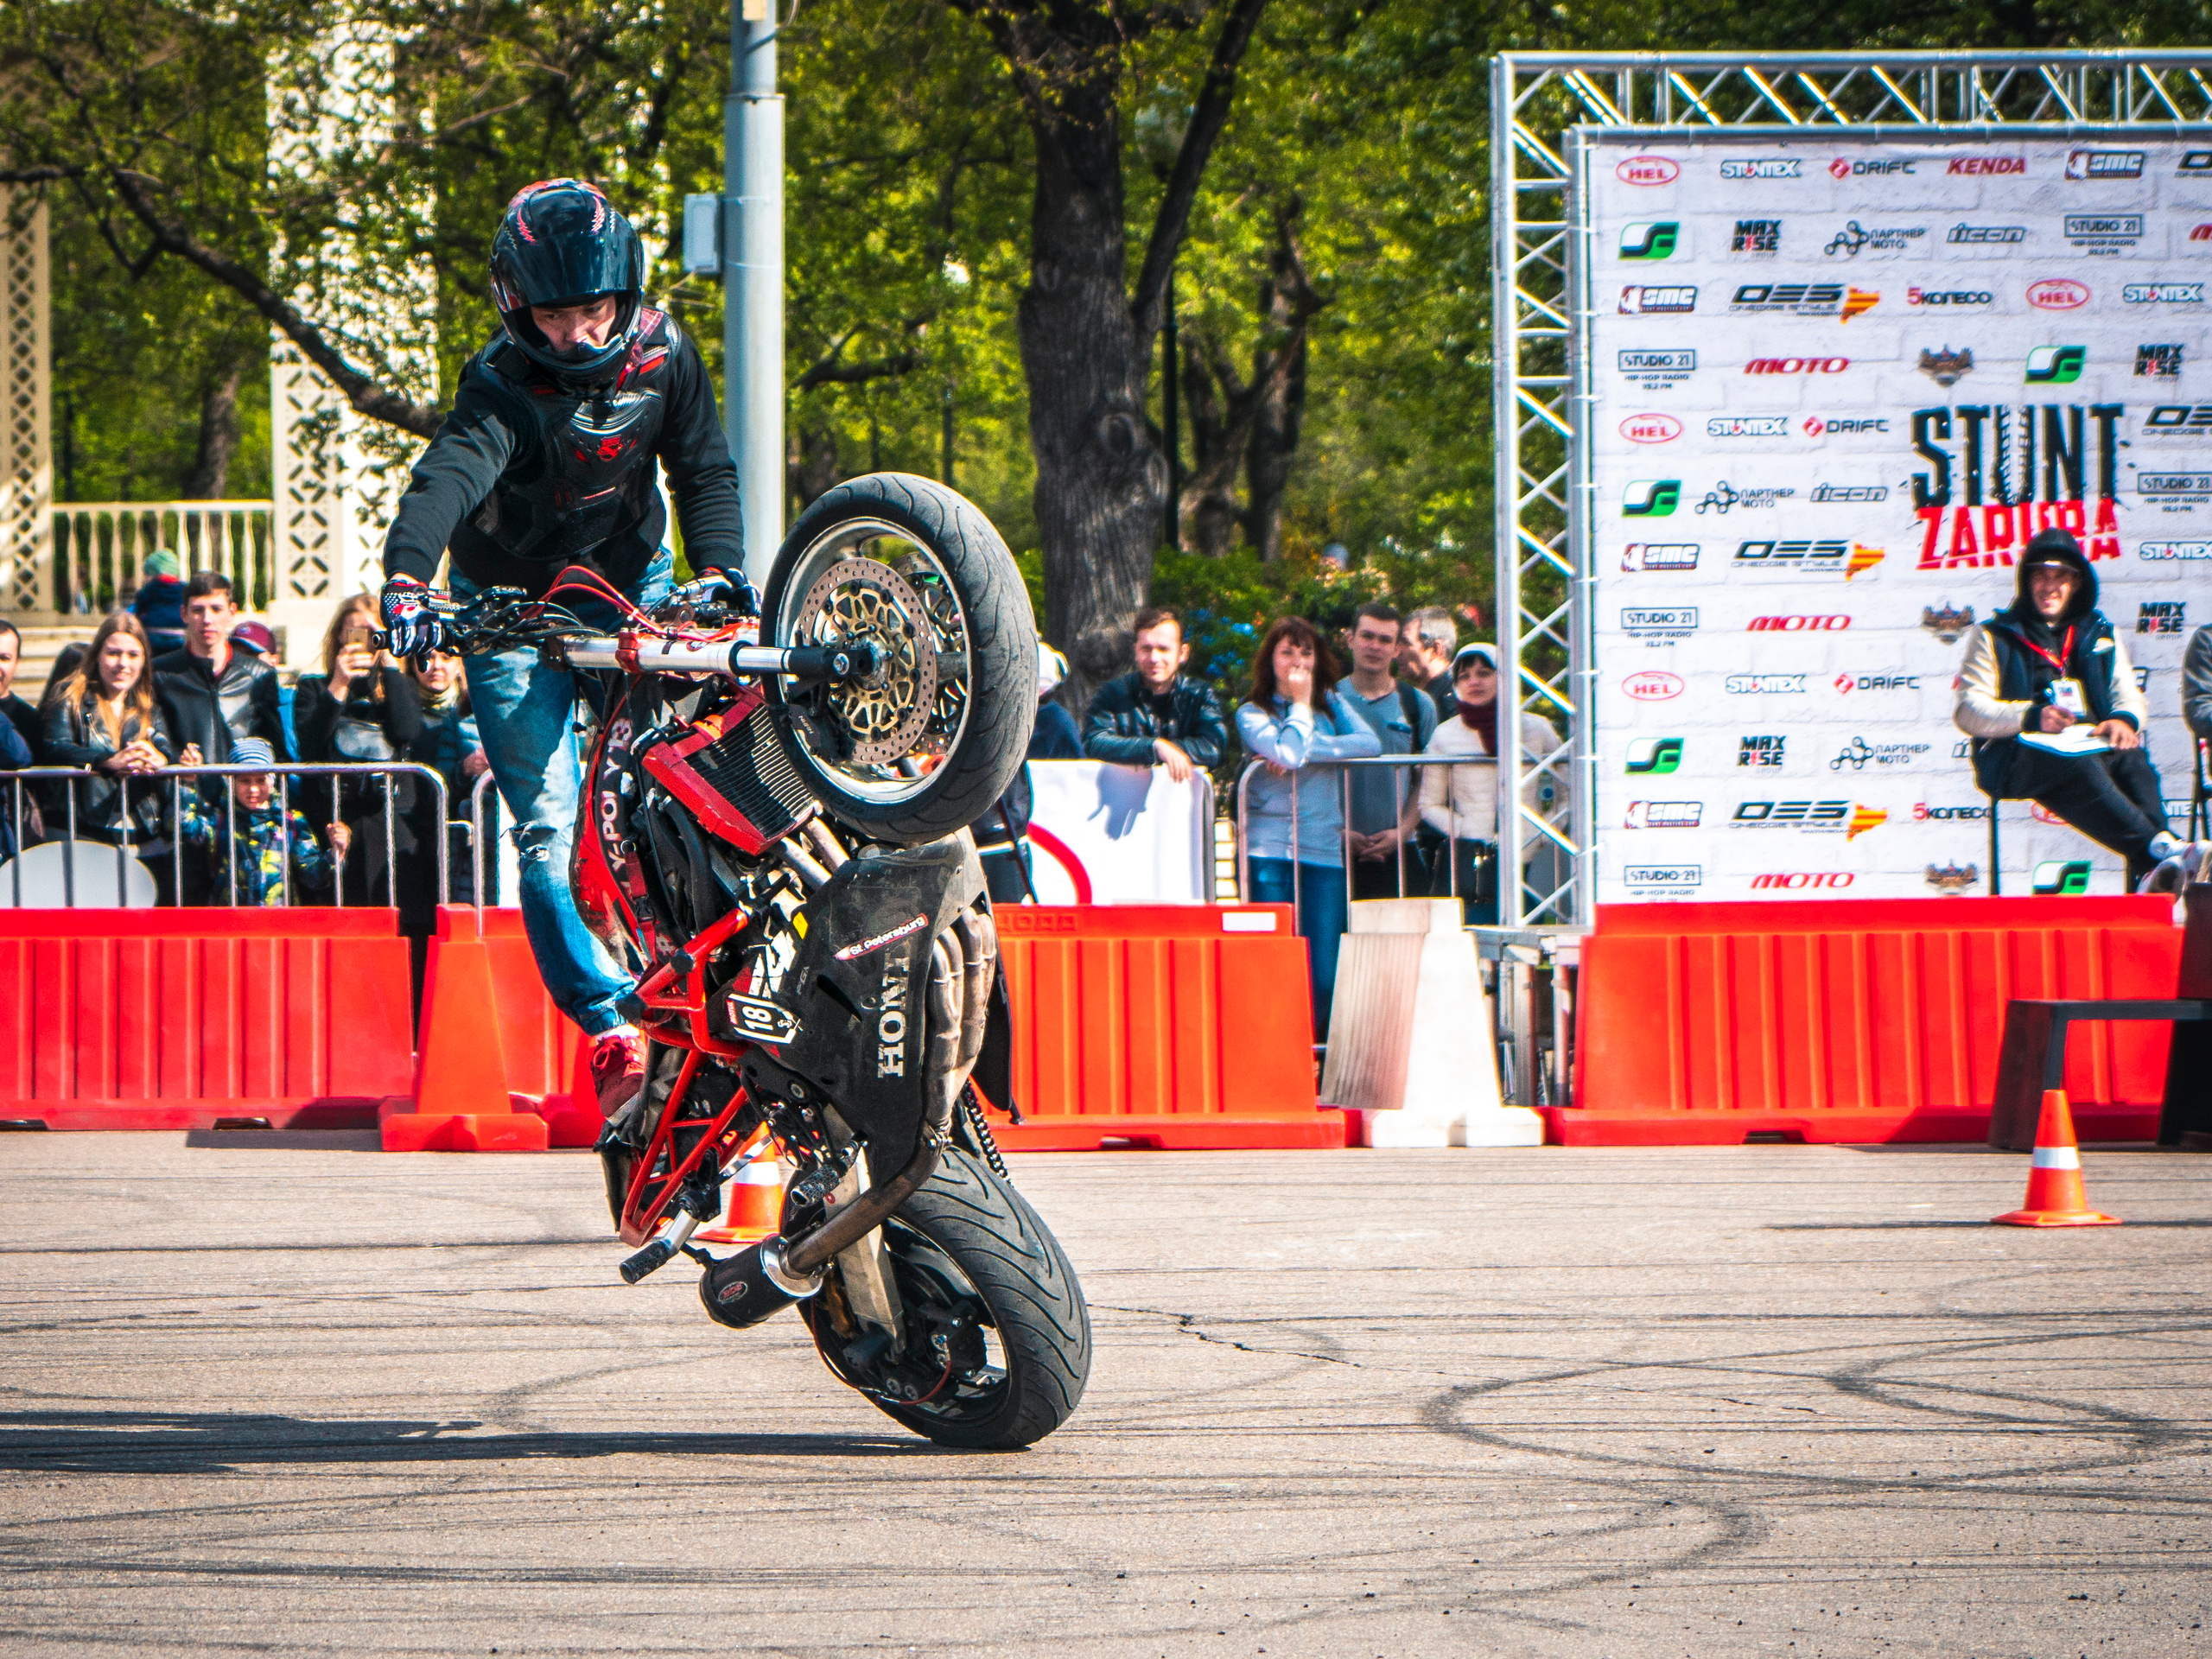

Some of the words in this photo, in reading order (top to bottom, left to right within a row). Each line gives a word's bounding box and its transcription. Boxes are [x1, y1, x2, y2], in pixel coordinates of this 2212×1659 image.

[1946, 157, 2026, 175] KENDA
[1734, 220, 1783, 236] MAX
[1871, 228, 1926, 238] ПАРТНЕР
[2070, 219, 2120, 232] STUDIO
[2124, 219, 2137, 232] 21
[2137, 344, 2185, 359] MAX
[1624, 354, 1673, 367] STUDIO
[1677, 354, 1689, 366] 21
[2145, 405, 2212, 426] OE
[1910, 403, 2125, 511] STUNT
[2145, 477, 2193, 489] STUDIO
[1740, 488, 1796, 498] ПАРТНЕР
[2139, 541, 2212, 561] STUNTE
[2139, 602, 2187, 618] MAX
[1627, 612, 1675, 624] STUDIO
[1680, 612, 1692, 624] 21
[1740, 735, 1787, 752] MAX
[1875, 744, 1930, 754] ПАРТНЕР
[1630, 870, 1679, 881] STUDIO
[1684, 869, 1695, 880] 21
[741, 1006, 773, 1032] 18
